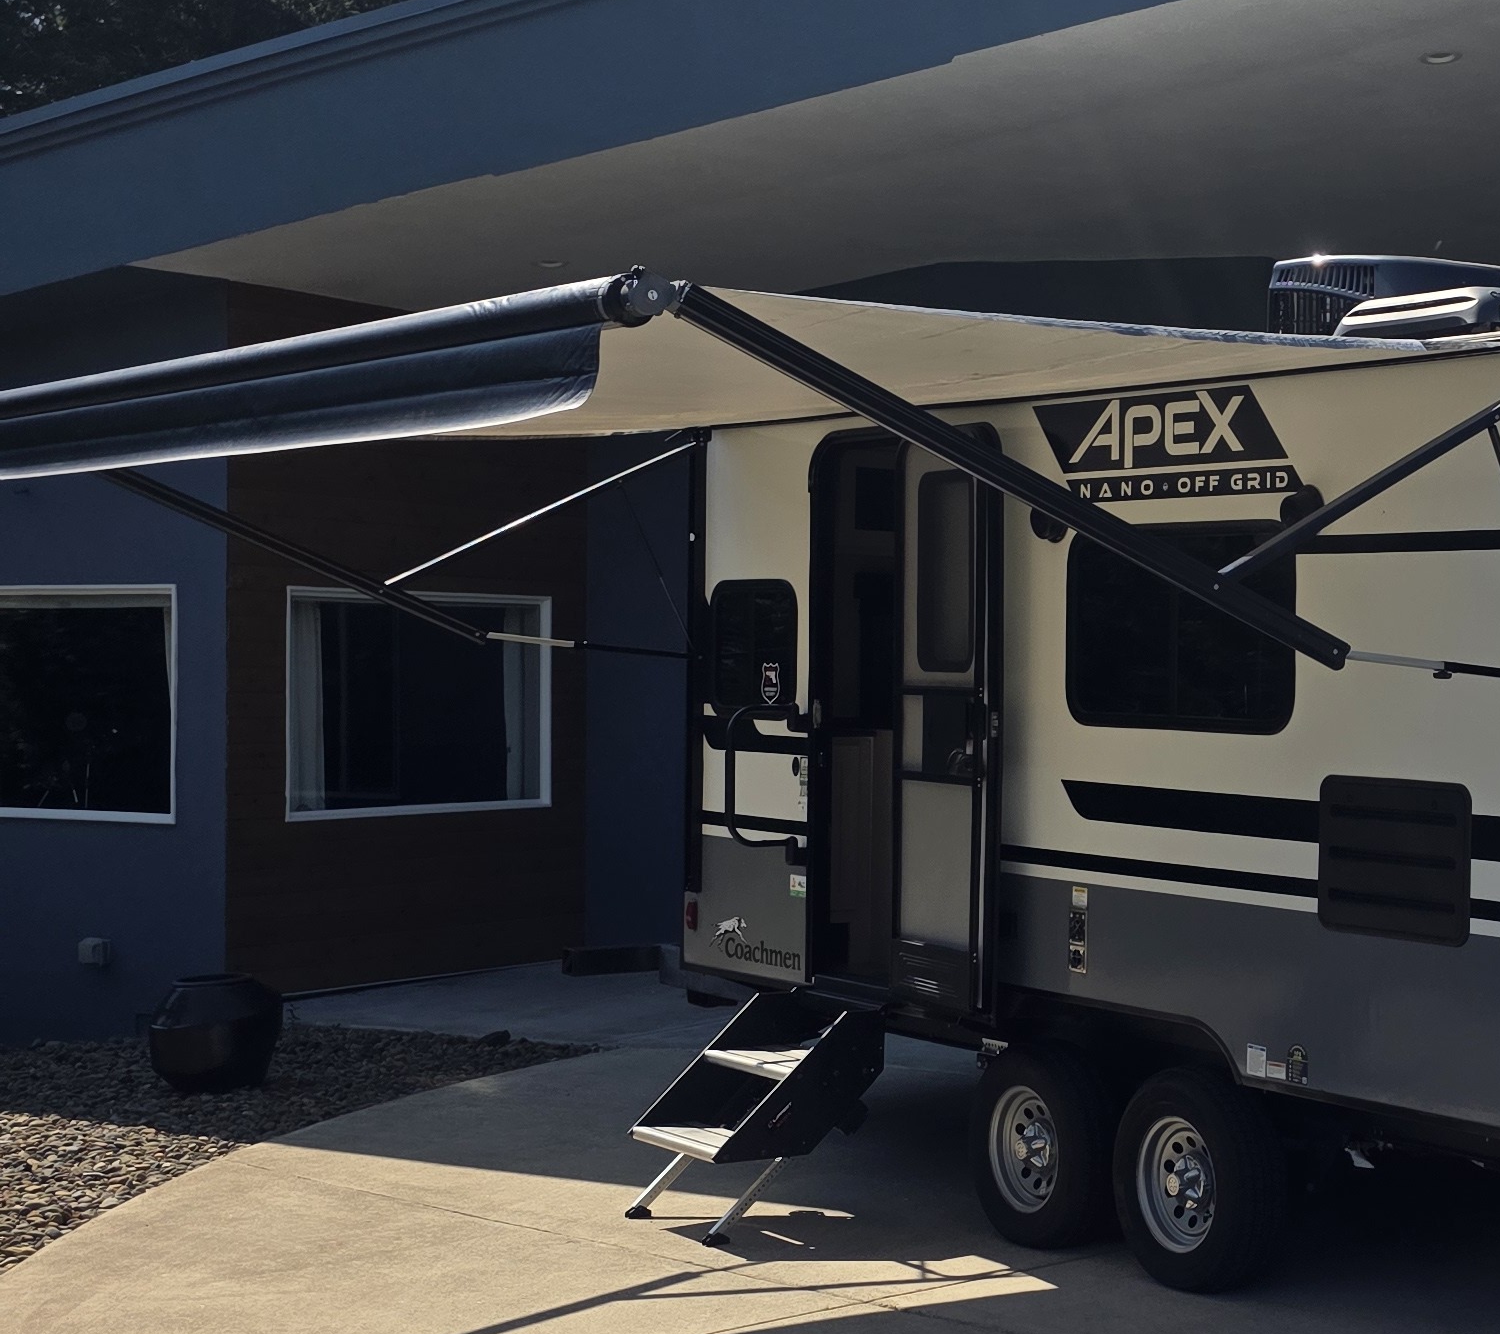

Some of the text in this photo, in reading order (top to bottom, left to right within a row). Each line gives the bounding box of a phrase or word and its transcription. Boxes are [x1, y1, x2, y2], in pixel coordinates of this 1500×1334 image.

[1069, 390, 1245, 468] APEX
[1079, 471, 1289, 499] NANO OFF GRID
[724, 936, 802, 971] Coachmen
